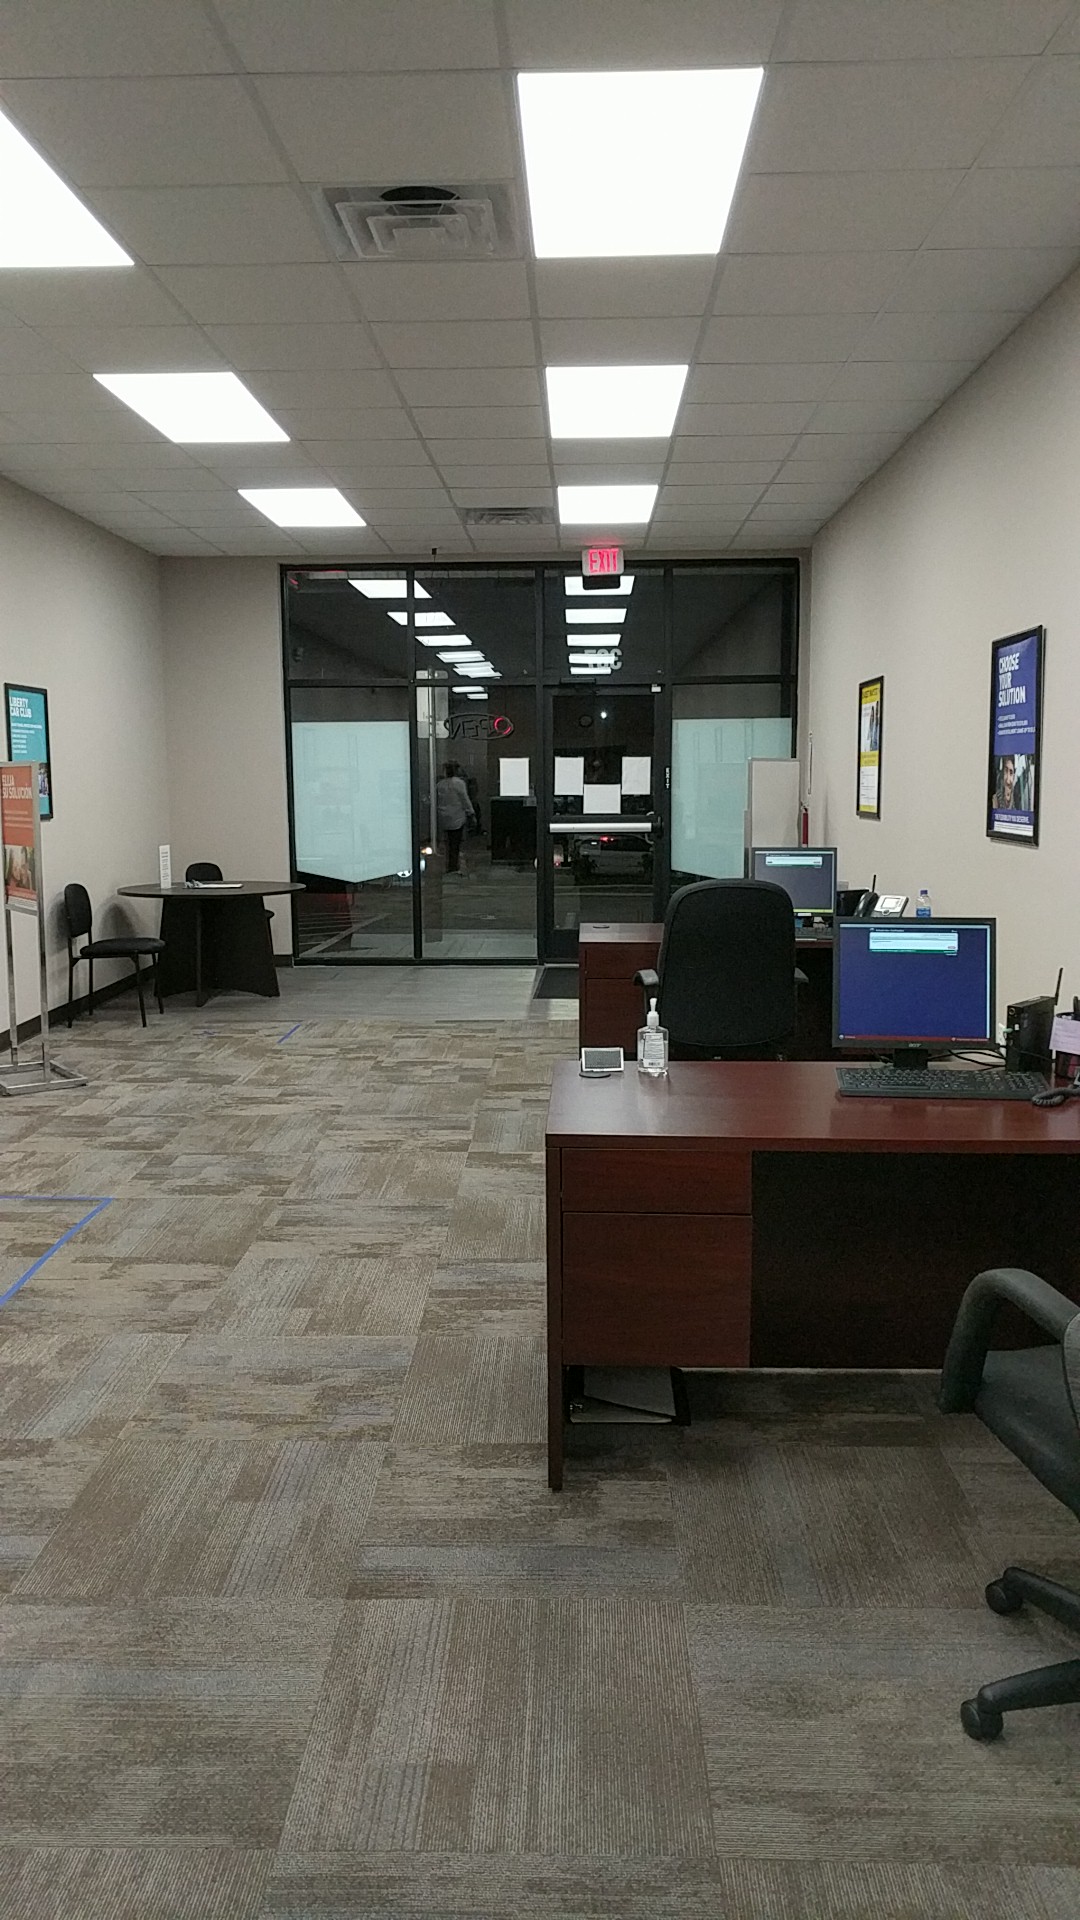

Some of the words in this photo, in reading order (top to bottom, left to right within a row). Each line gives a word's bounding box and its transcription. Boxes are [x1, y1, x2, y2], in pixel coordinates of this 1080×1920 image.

[588, 548, 619, 574] EXIT
[998, 653, 1020, 674] CHOOSE
[998, 672, 1012, 690] YOUR
[9, 696, 29, 708] LIBERTY
[998, 686, 1026, 707] SOLUTION
[10, 706, 20, 717] CAR
[20, 707, 32, 718] CLUB
